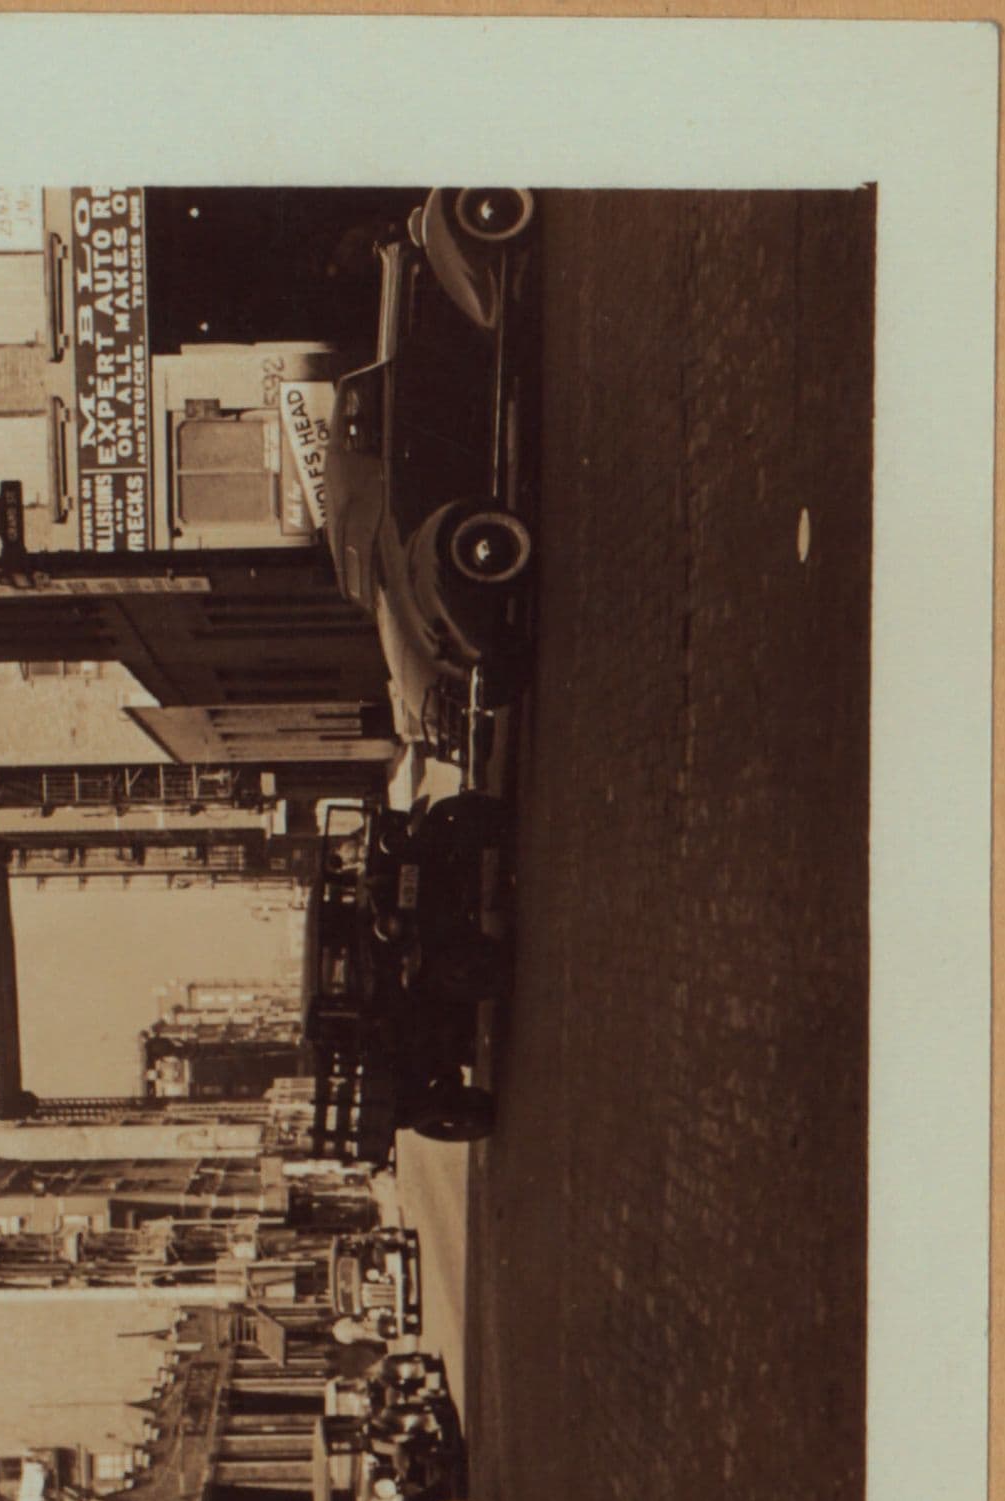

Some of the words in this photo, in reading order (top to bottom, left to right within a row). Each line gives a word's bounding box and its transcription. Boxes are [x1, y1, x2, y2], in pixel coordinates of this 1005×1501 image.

[74, 197, 94, 346] BLO
[92, 228, 114, 315] AUTO
[113, 226, 131, 332] MAKES
[130, 233, 143, 309] TRUCKS
[96, 331, 116, 465] EXPERT
[115, 344, 132, 404] ALL
[262, 357, 285, 406] 592
[79, 375, 96, 448] M.
[117, 418, 133, 457] ON
[286, 389, 316, 446] HEAD
[137, 431, 146, 464] AND
[81, 478, 92, 499] ON
[95, 474, 115, 552] OLLISIONS
[116, 498, 124, 533] AND
[303, 451, 327, 525] OLF'S
[82, 503, 93, 550] XPERTS
